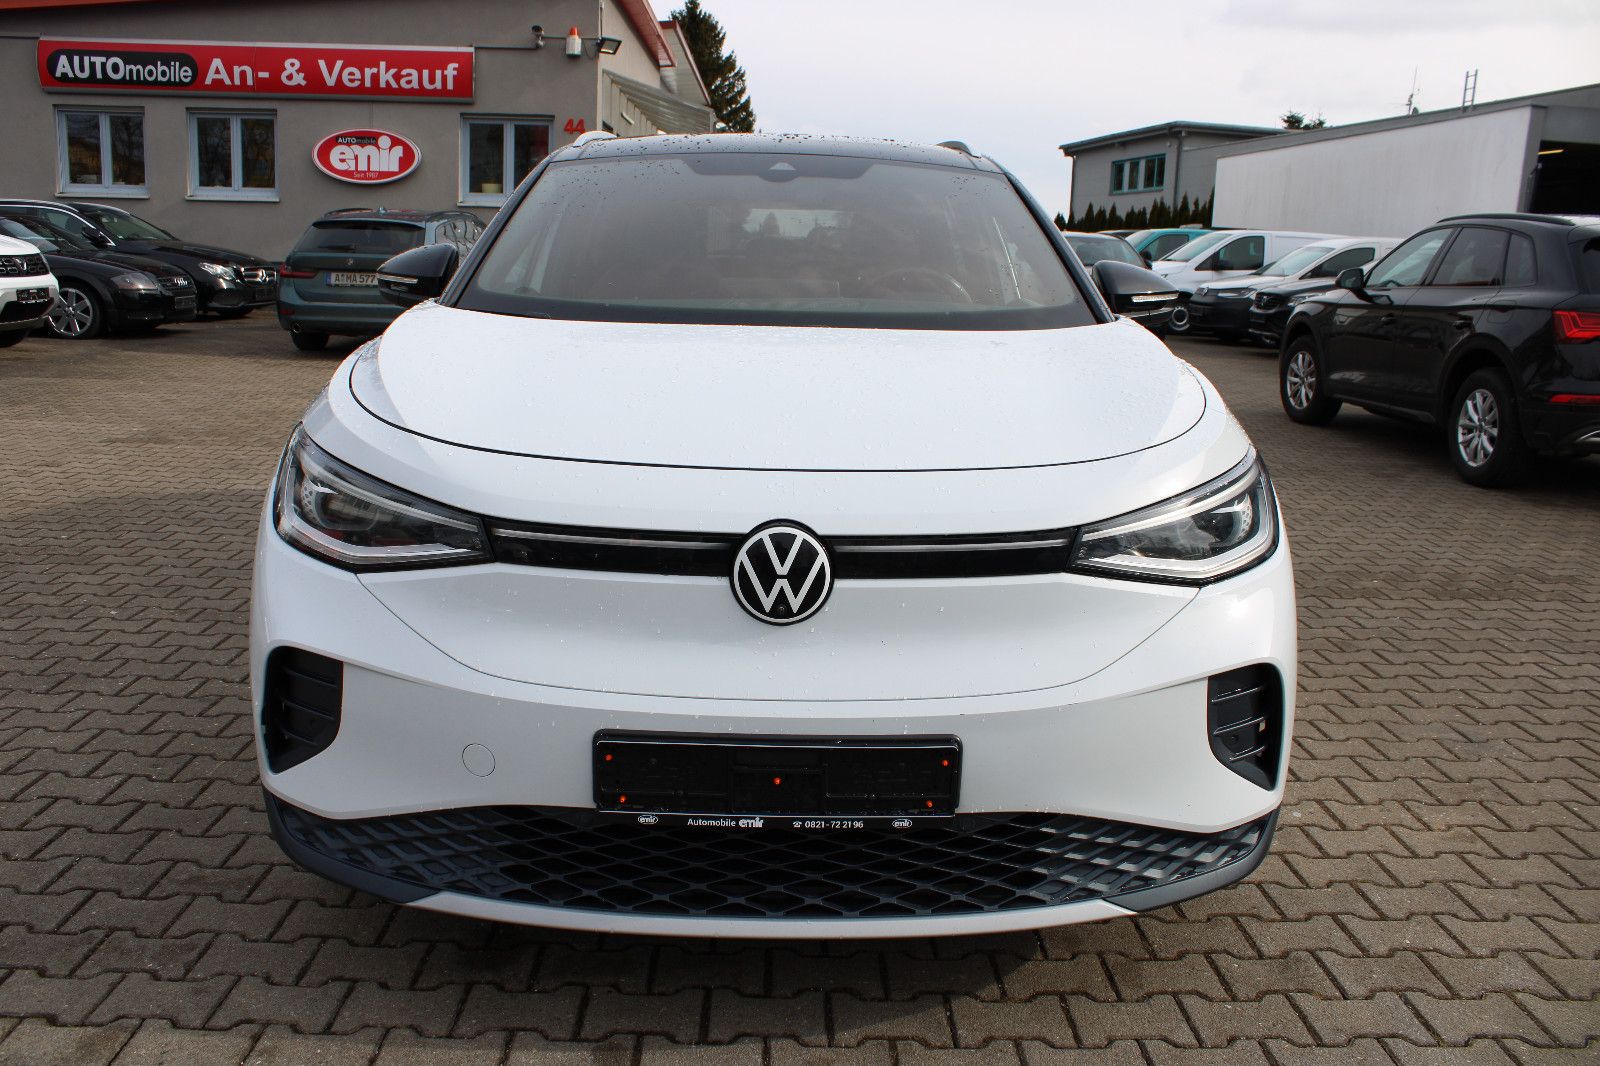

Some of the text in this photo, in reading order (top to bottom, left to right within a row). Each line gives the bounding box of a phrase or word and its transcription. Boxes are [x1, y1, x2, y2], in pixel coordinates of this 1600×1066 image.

[54, 54, 460, 91] AUTOmobile An- & Verkauf
[563, 118, 586, 135] 44
[329, 135, 403, 172] emir
[640, 815, 657, 824] emir
[687, 816, 764, 828] Automobile emir
